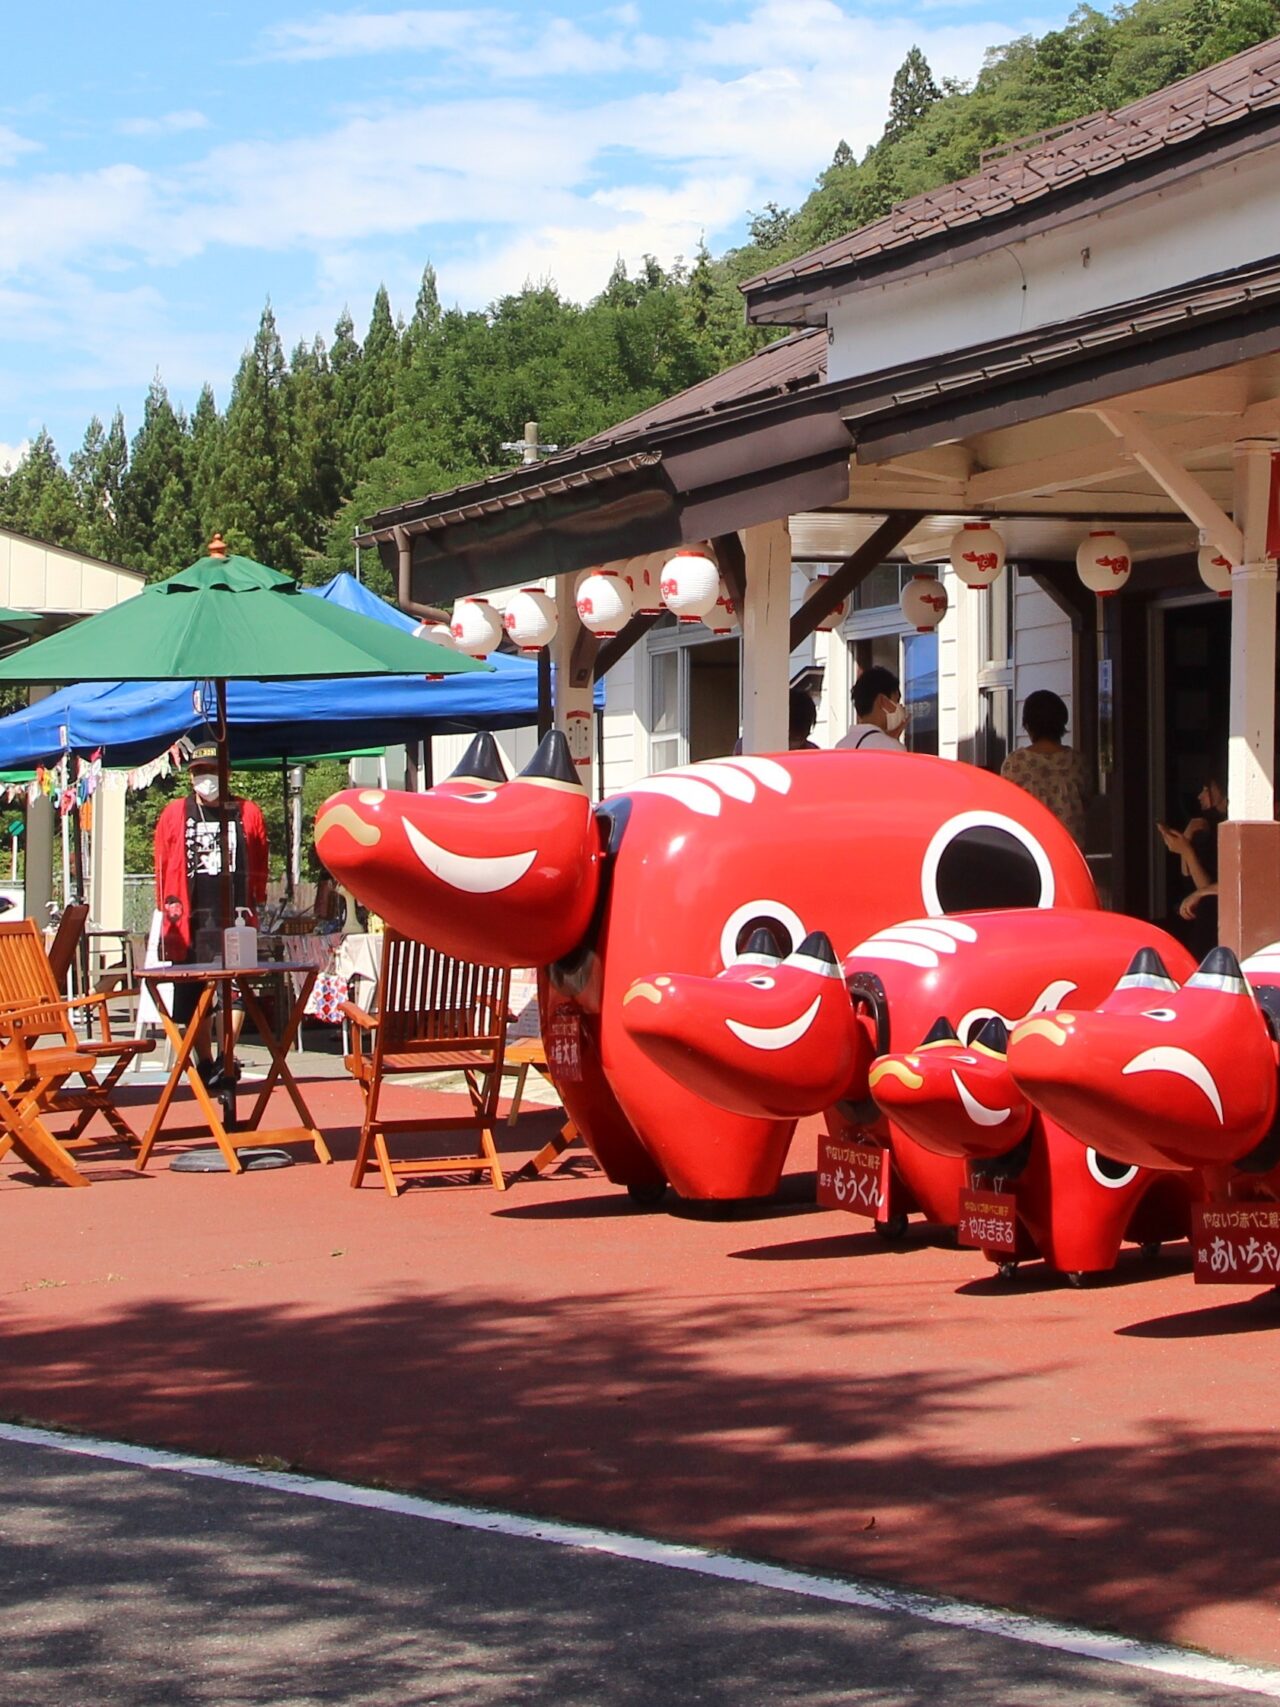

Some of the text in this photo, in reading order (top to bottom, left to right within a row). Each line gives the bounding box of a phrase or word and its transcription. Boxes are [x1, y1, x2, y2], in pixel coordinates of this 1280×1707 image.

[833, 1166, 885, 1208] もうくん
[968, 1216, 1014, 1244] やなぎまる
